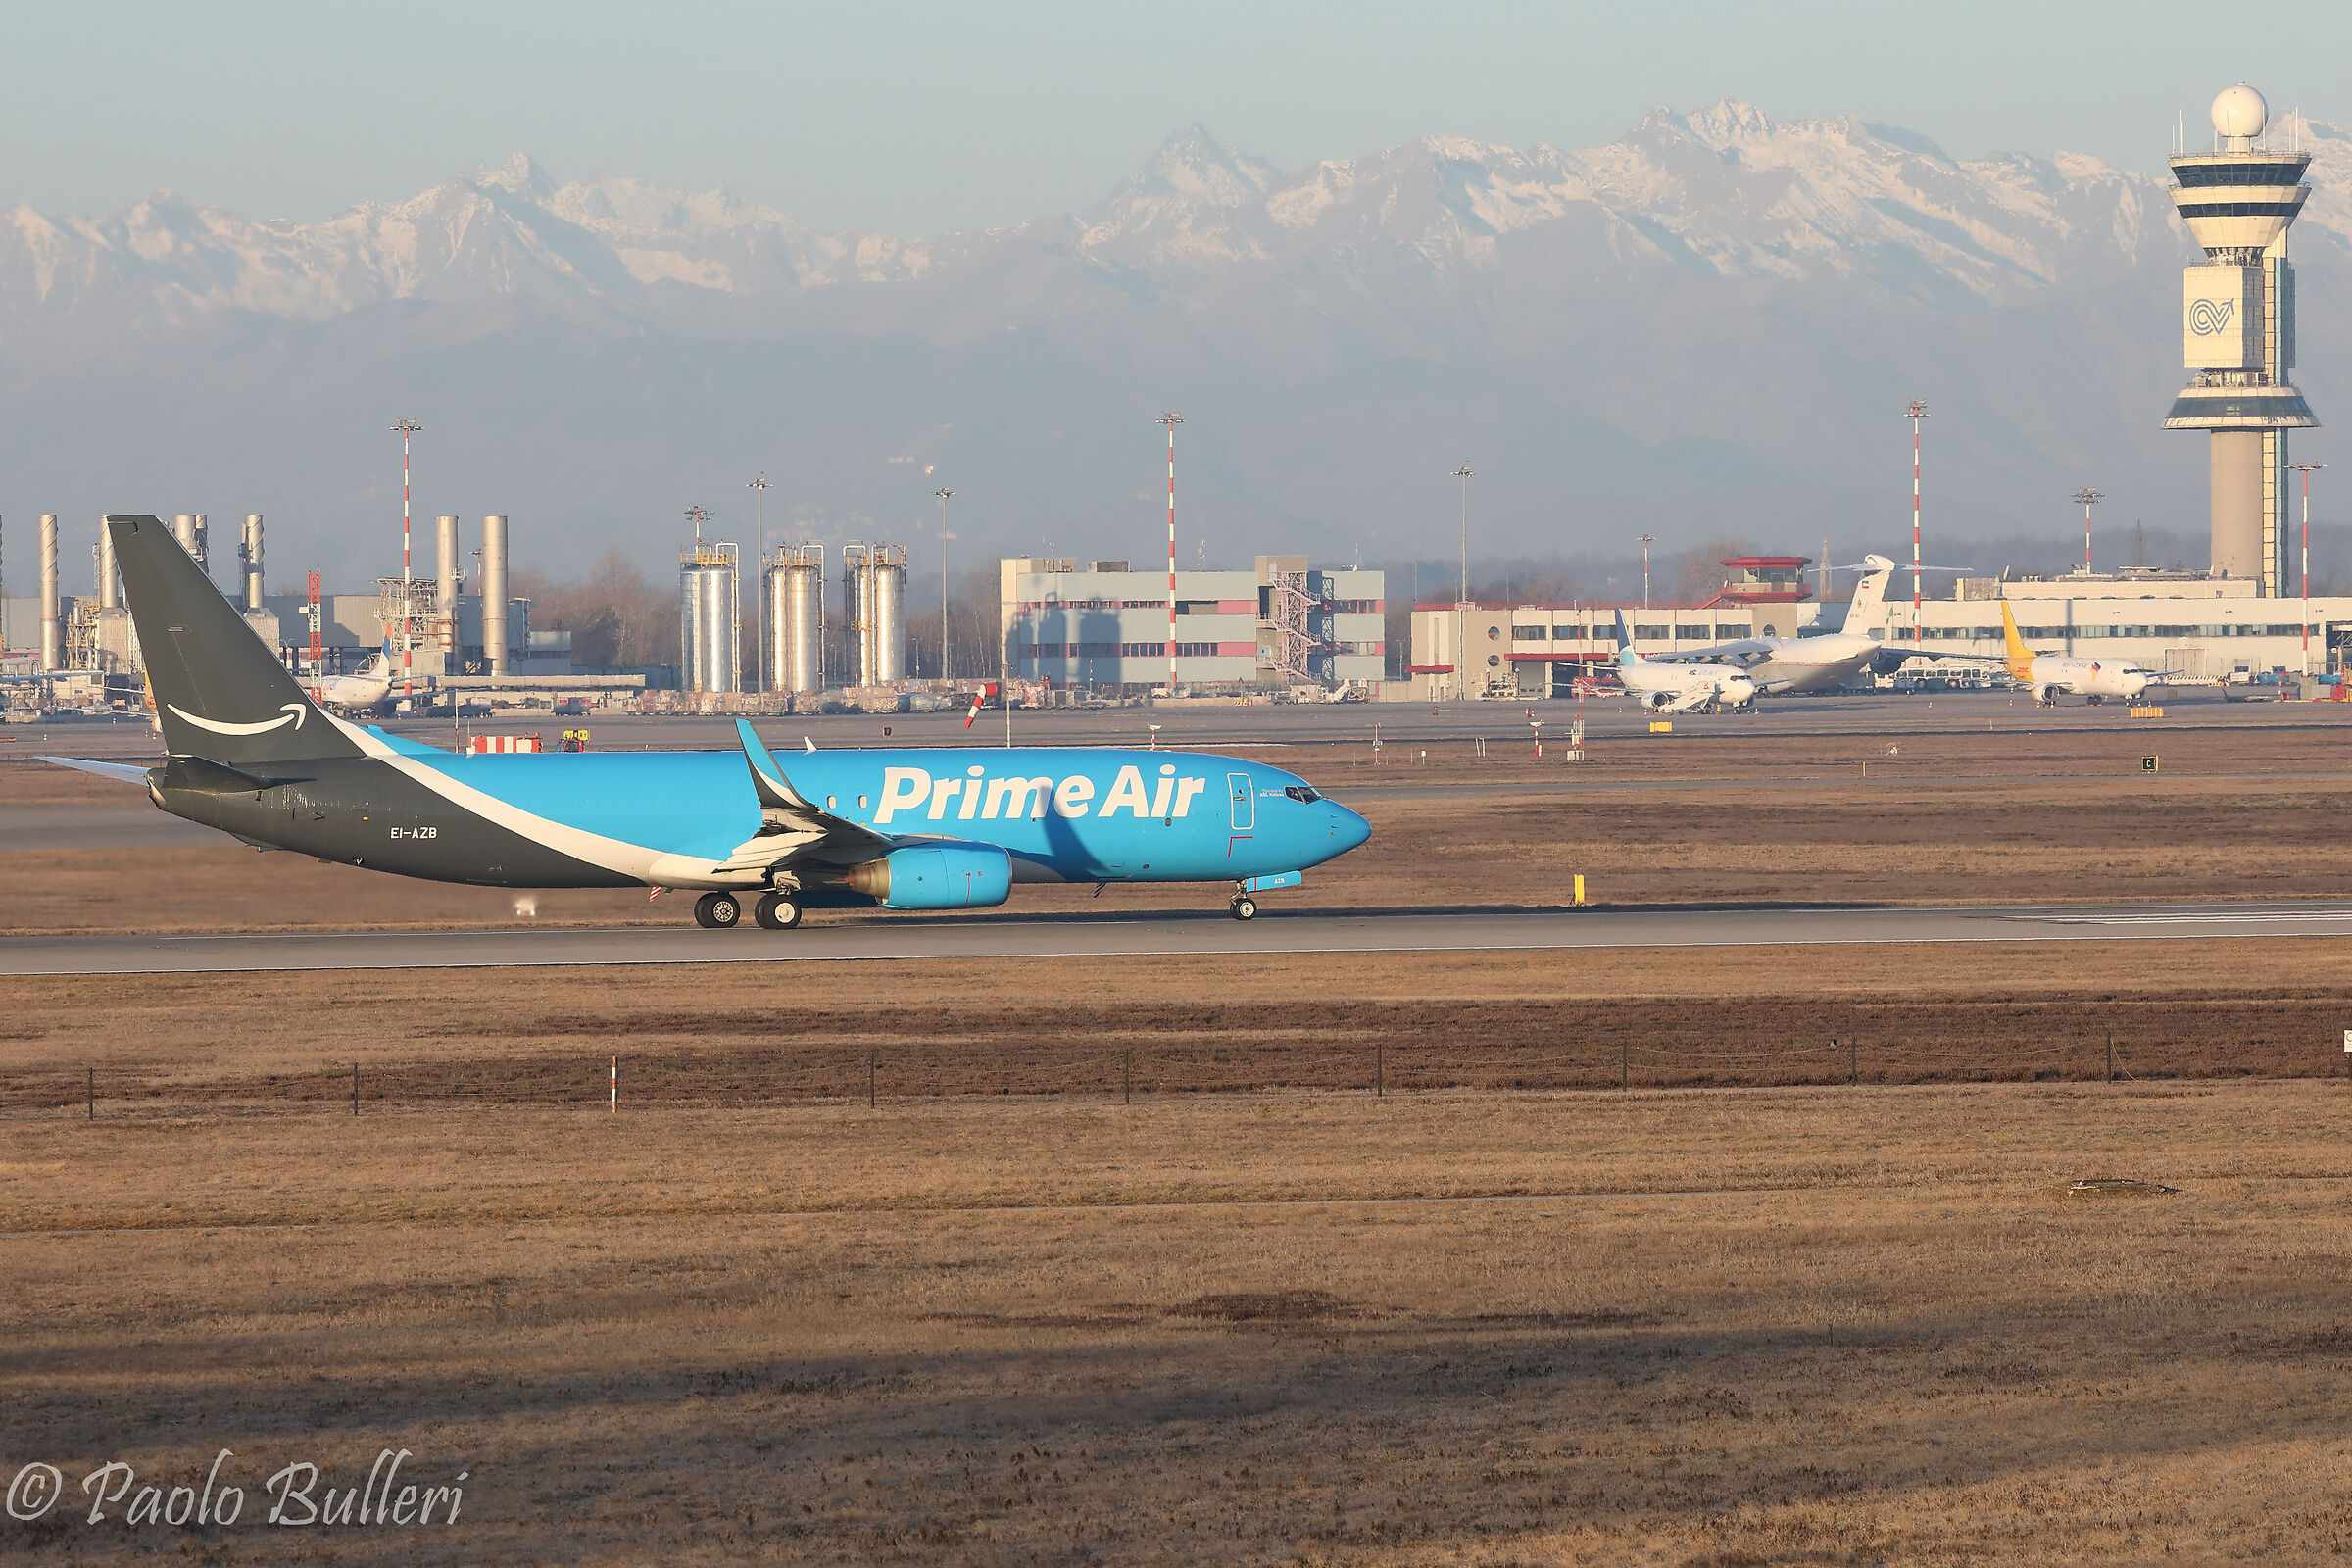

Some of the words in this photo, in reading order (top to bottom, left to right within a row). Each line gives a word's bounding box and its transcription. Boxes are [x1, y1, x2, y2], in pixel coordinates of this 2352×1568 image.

[873, 765, 1096, 824] Prime
[1097, 764, 1206, 818] Air
[390, 827, 437, 839] EI-AZB
